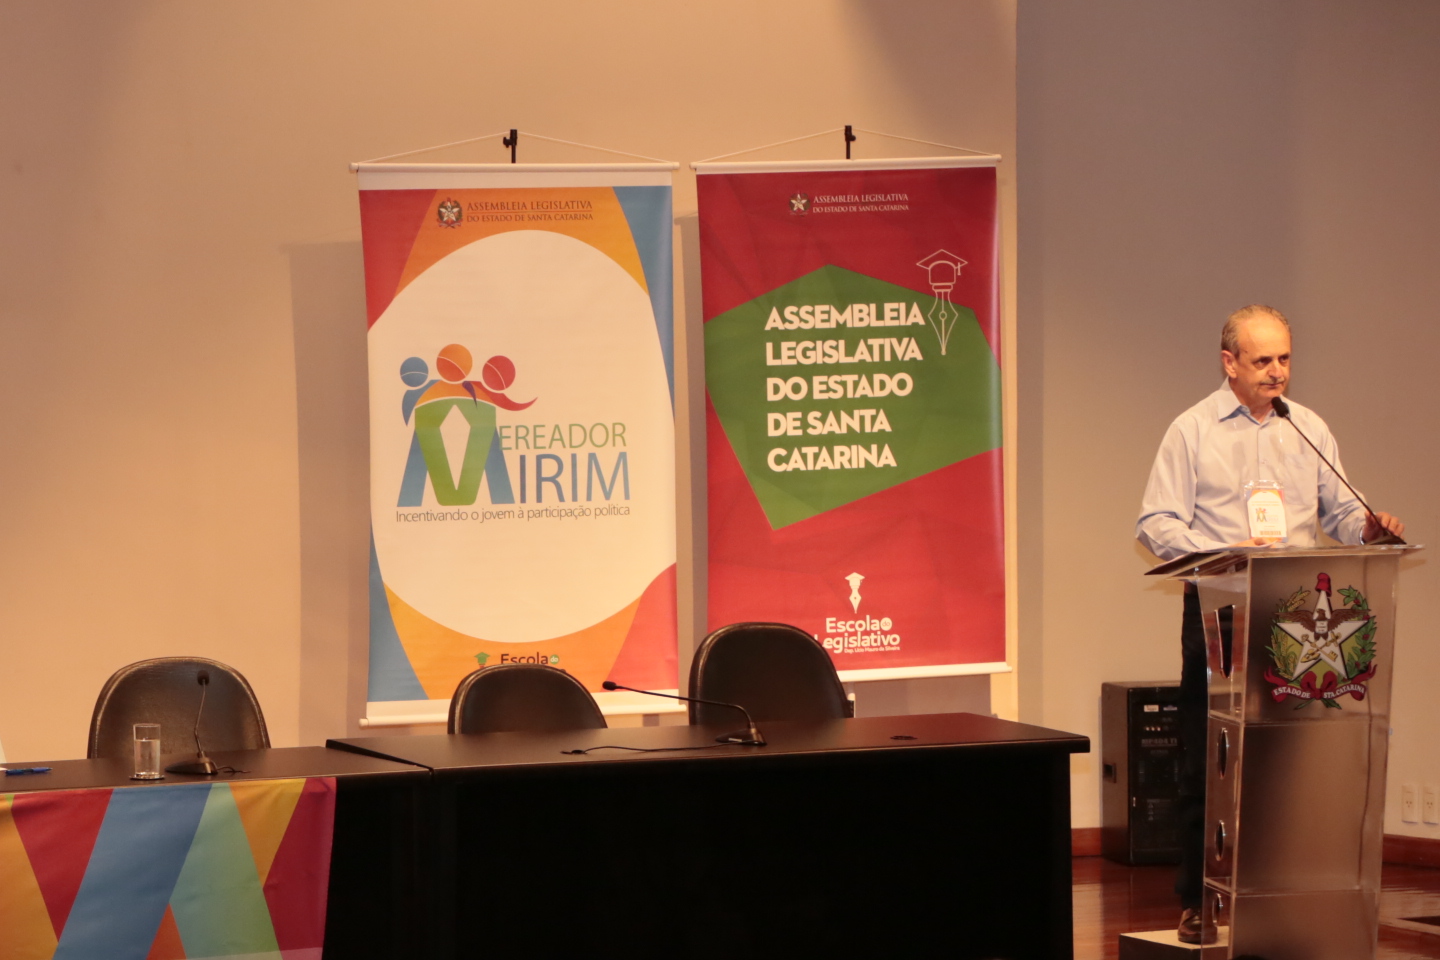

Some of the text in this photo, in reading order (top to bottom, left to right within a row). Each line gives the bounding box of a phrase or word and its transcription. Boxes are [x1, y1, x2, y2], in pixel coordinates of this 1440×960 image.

[467, 200, 593, 211] ASSEMBLEIA LEGISLATIVA
[813, 193, 909, 203] ASSEMBLEIA LEGISLATIVA
[482, 214, 512, 222] ESTADO
[514, 214, 525, 222] DE
[554, 213, 593, 221] CATARINA
[764, 302, 925, 331] ASSEMBLEIA
[765, 337, 923, 366] LEGISLATIVA
[766, 372, 913, 402] DO ESTADO
[766, 408, 892, 437] DE SANTA
[766, 444, 897, 473] CATARINA
[396, 504, 630, 523] Incentivando o jovem à participação política
[825, 614, 880, 633] Escola
[1274, 687, 1301, 695] ESTADO
